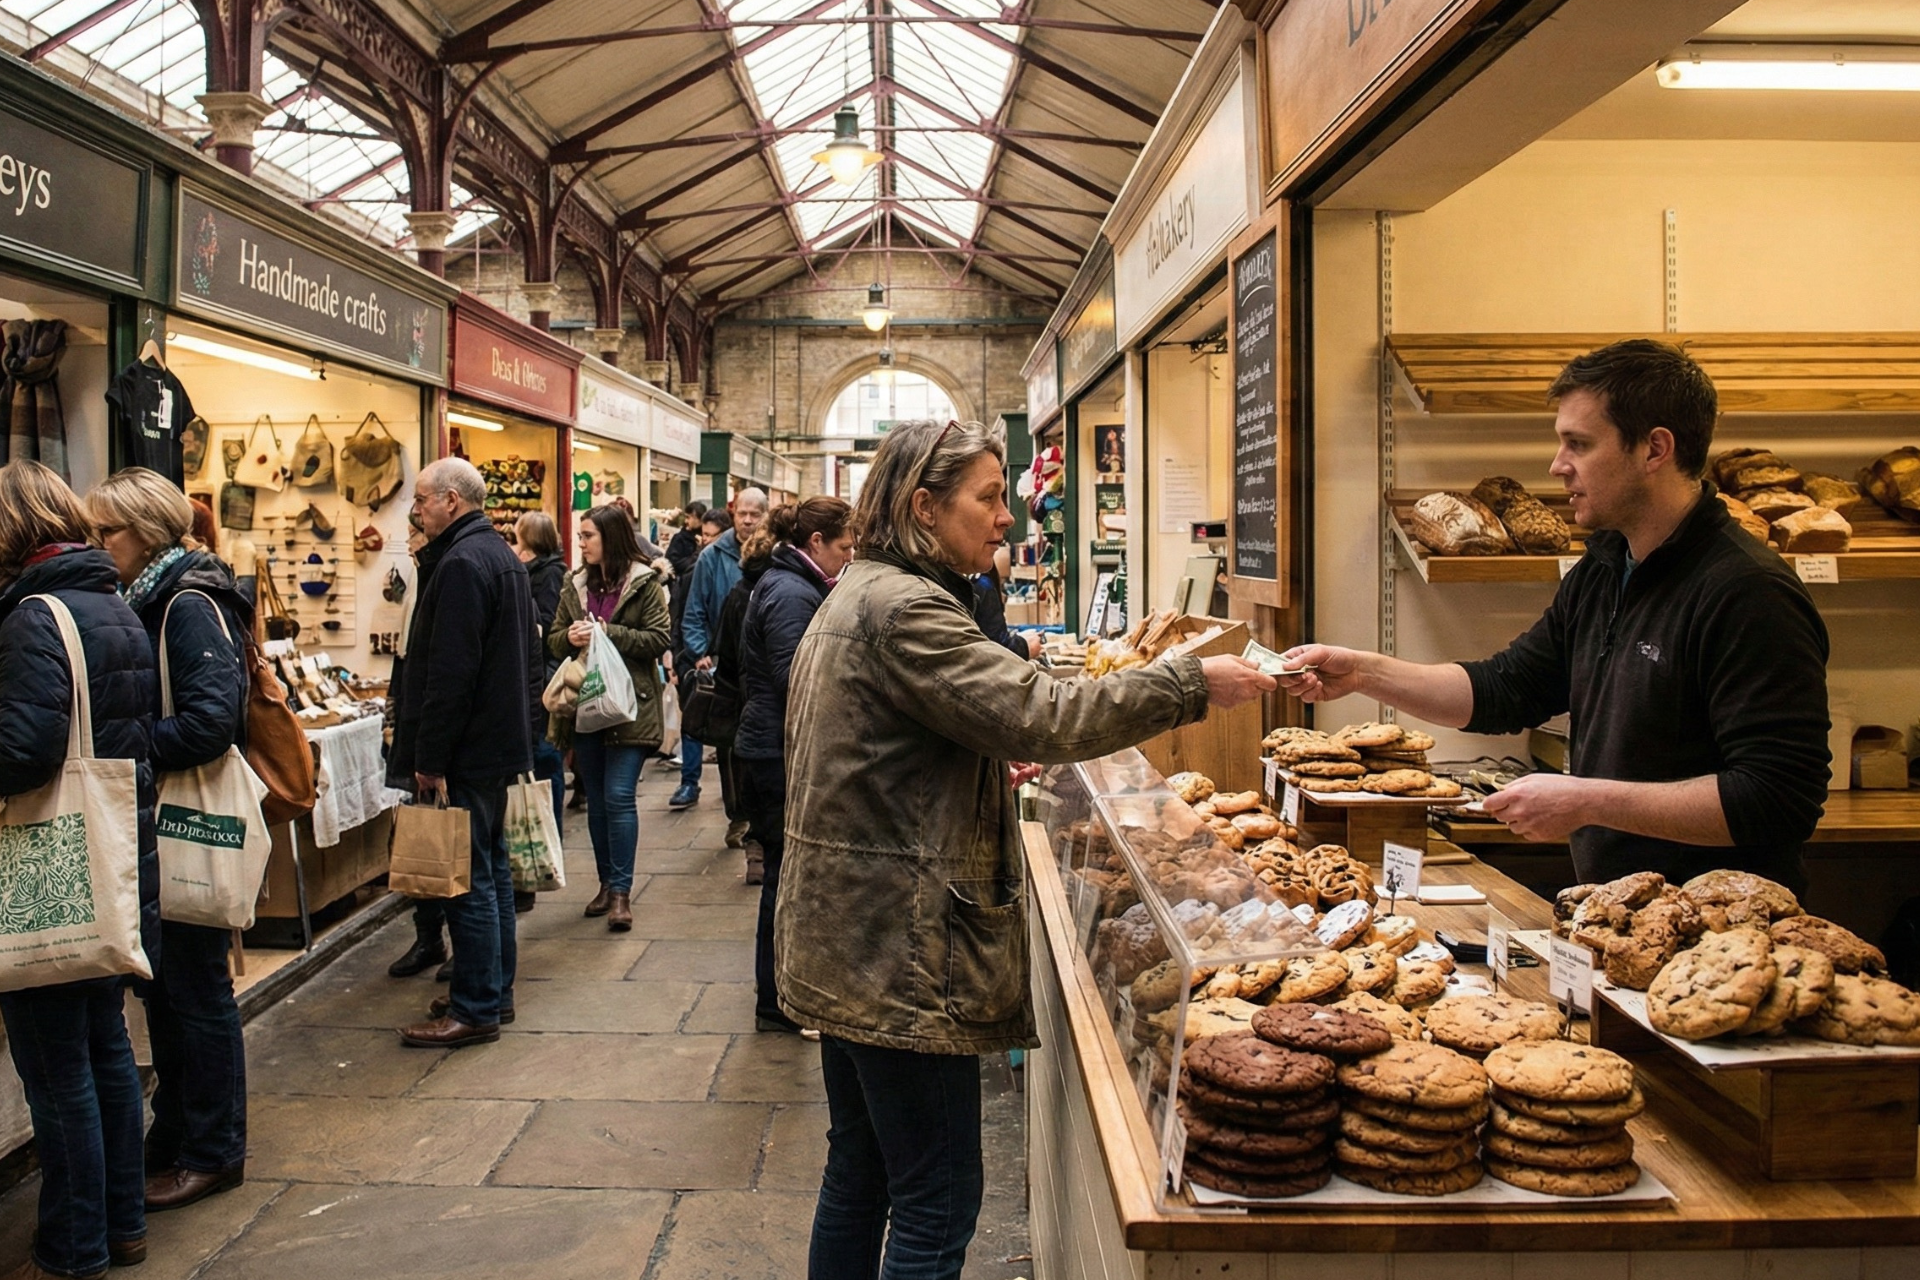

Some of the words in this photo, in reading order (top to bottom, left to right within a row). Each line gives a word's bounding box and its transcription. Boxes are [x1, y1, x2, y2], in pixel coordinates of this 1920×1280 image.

[0, 154, 51, 216] eys
[239, 238, 339, 318] Handmade
[344, 292, 386, 335] crafts
